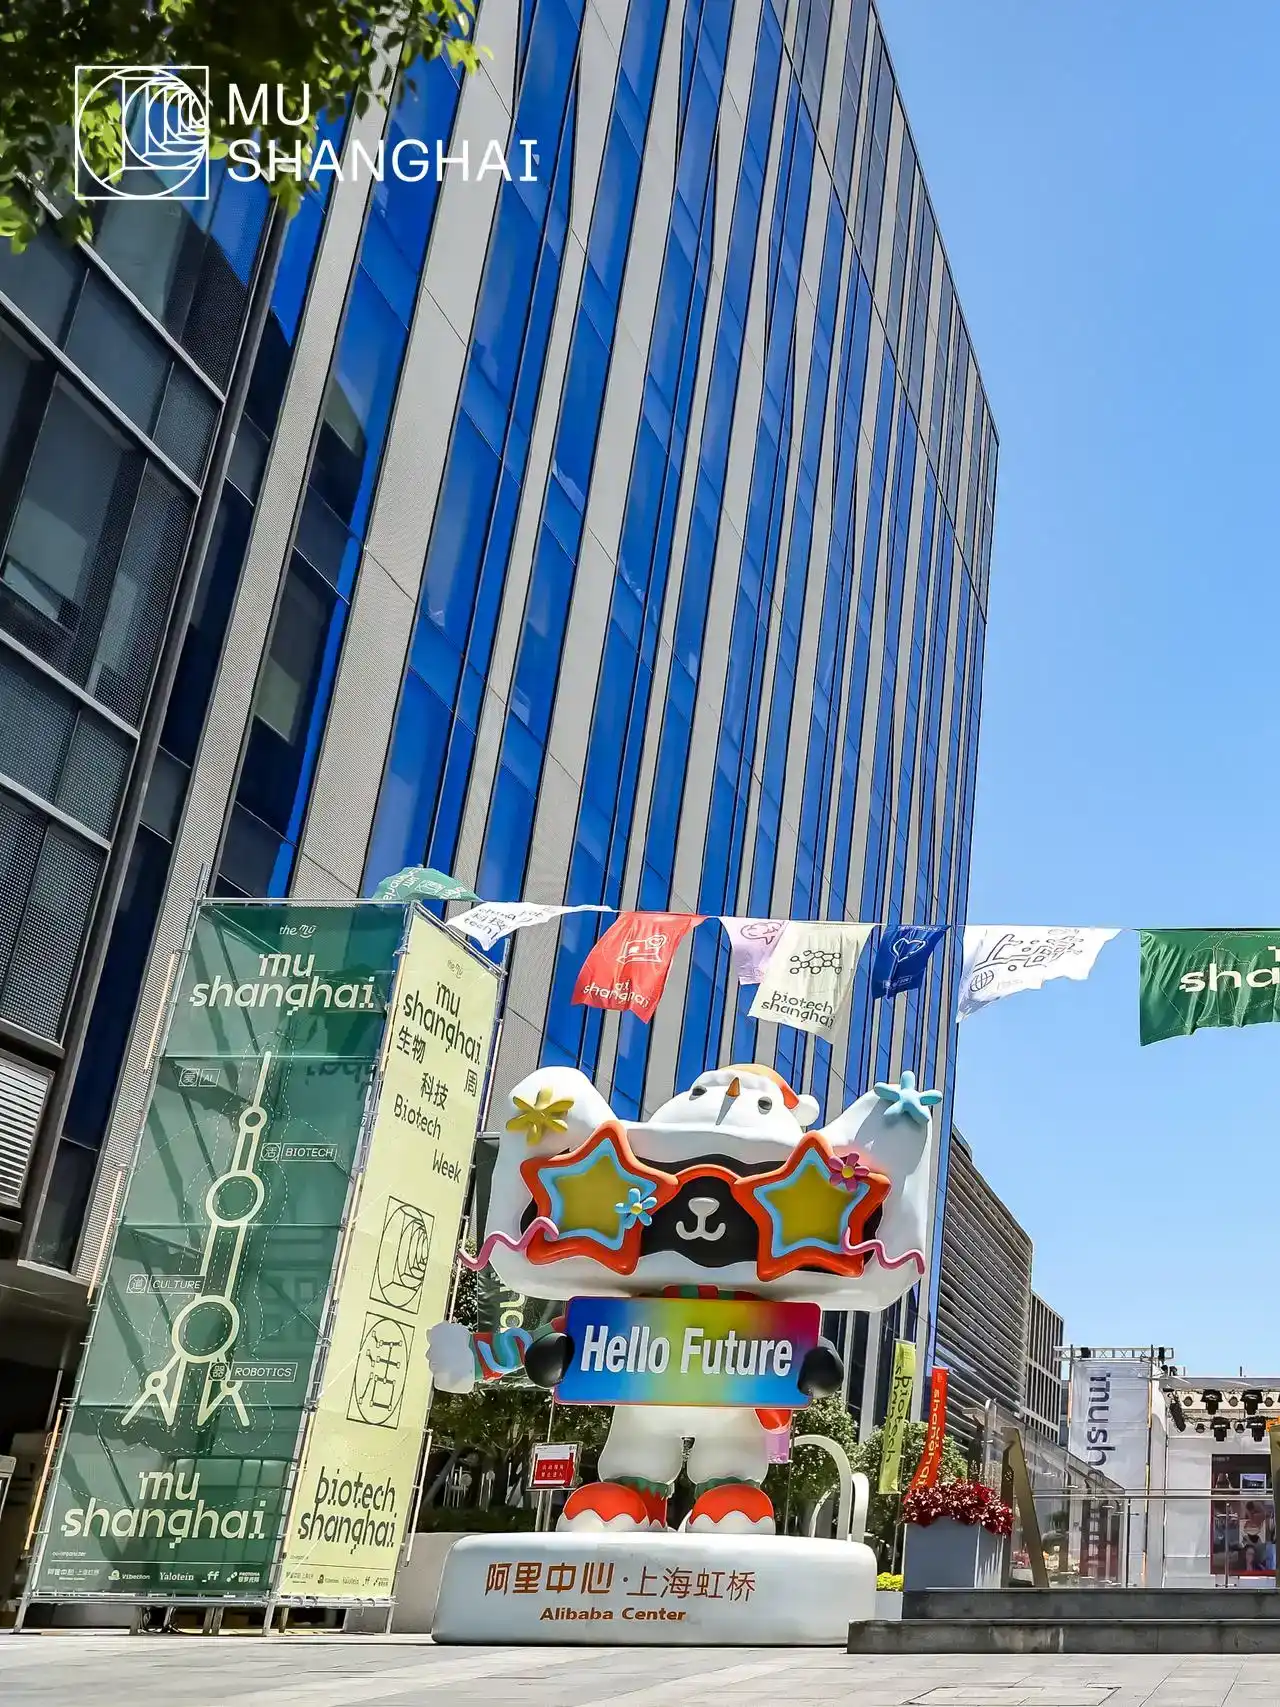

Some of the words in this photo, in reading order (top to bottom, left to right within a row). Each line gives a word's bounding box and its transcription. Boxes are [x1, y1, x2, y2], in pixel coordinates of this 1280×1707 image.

[258, 953, 316, 977] mu
[188, 975, 375, 1016] shanghai
[436, 981, 461, 1018] mu
[771, 990, 834, 1015] biotech
[403, 990, 483, 1066] shanghai
[761, 999, 837, 1030] shanghai
[396, 1025, 427, 1064] 生物
[420, 1072, 449, 1111] 科技
[463, 1068, 478, 1097] 周
[393, 1093, 442, 1140] Biotech
[285, 1147, 335, 1157] BIOTECH
[432, 1148, 462, 1184] Week
[152, 1279, 202, 1290] CULTURE
[580, 1324, 671, 1375] Hello
[680, 1327, 793, 1377] Future
[234, 1367, 293, 1377] ROBOTICS
[139, 1469, 201, 1501] mu
[315, 1466, 397, 1514] biotech
[61, 1498, 266, 1549] shanghai
[297, 1508, 396, 1555] shanghai
[540, 1606, 614, 1621] Alibaba
[621, 1607, 687, 1622] Center
